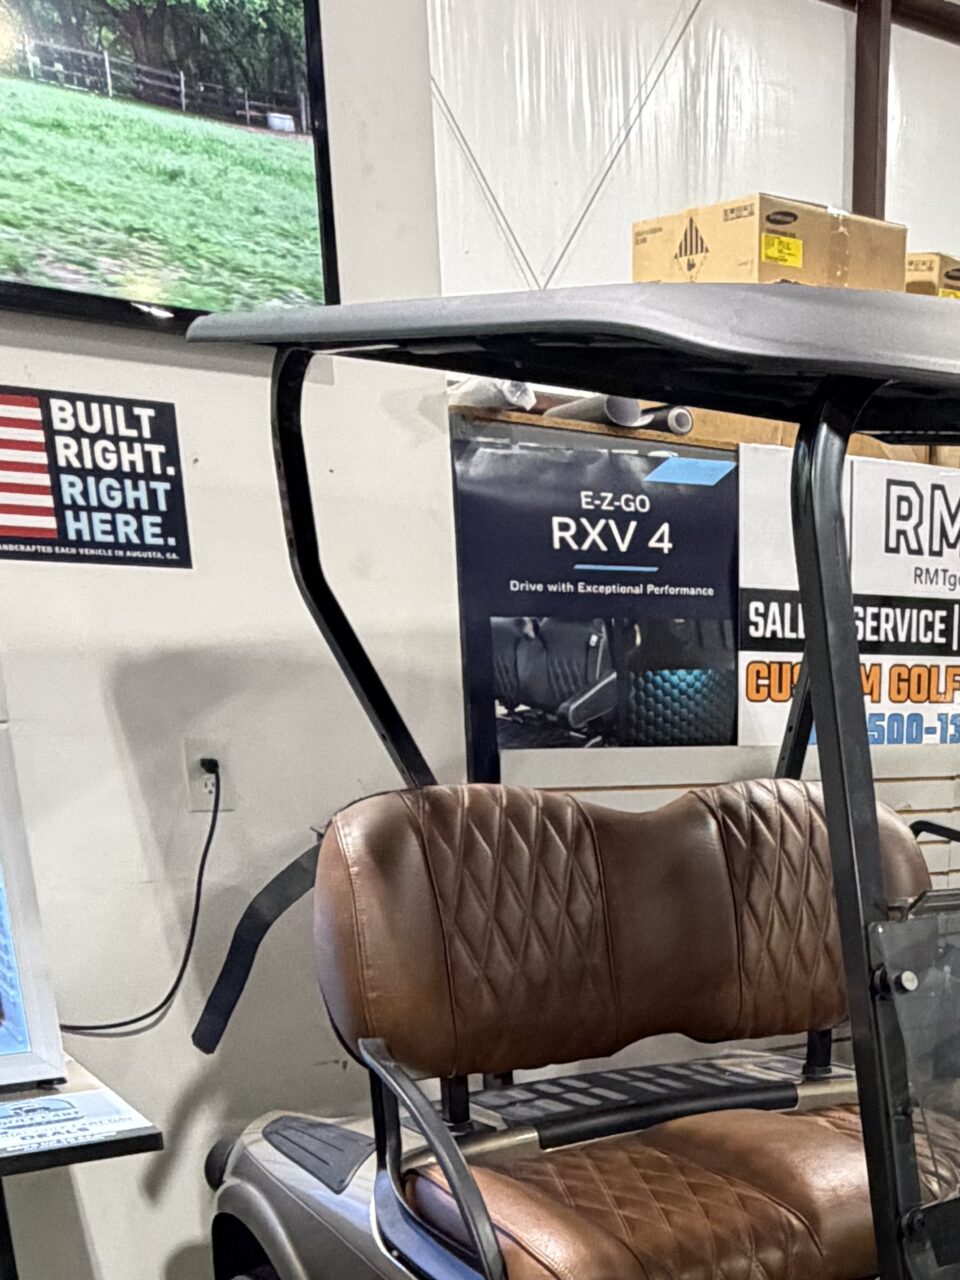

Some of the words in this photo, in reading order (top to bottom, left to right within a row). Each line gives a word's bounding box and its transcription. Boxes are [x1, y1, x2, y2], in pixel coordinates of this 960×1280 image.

[50, 398, 155, 438] BUILT
[55, 435, 175, 475] RIGHT.
[60, 473, 171, 511] RIGHT
[580, 490, 650, 512] E-Z-GO
[65, 509, 176, 546] HERE.
[551, 516, 638, 553] RXV
[647, 521, 673, 554] 4
[55, 546, 77, 555] EACH
[78, 547, 112, 557] VEHICLE
[509, 579, 543, 592] Drive
[547, 582, 574, 593] with
[577, 582, 643, 595] Exceptional
[647, 584, 714, 597] Performance
[749, 601, 805, 639] SAL
